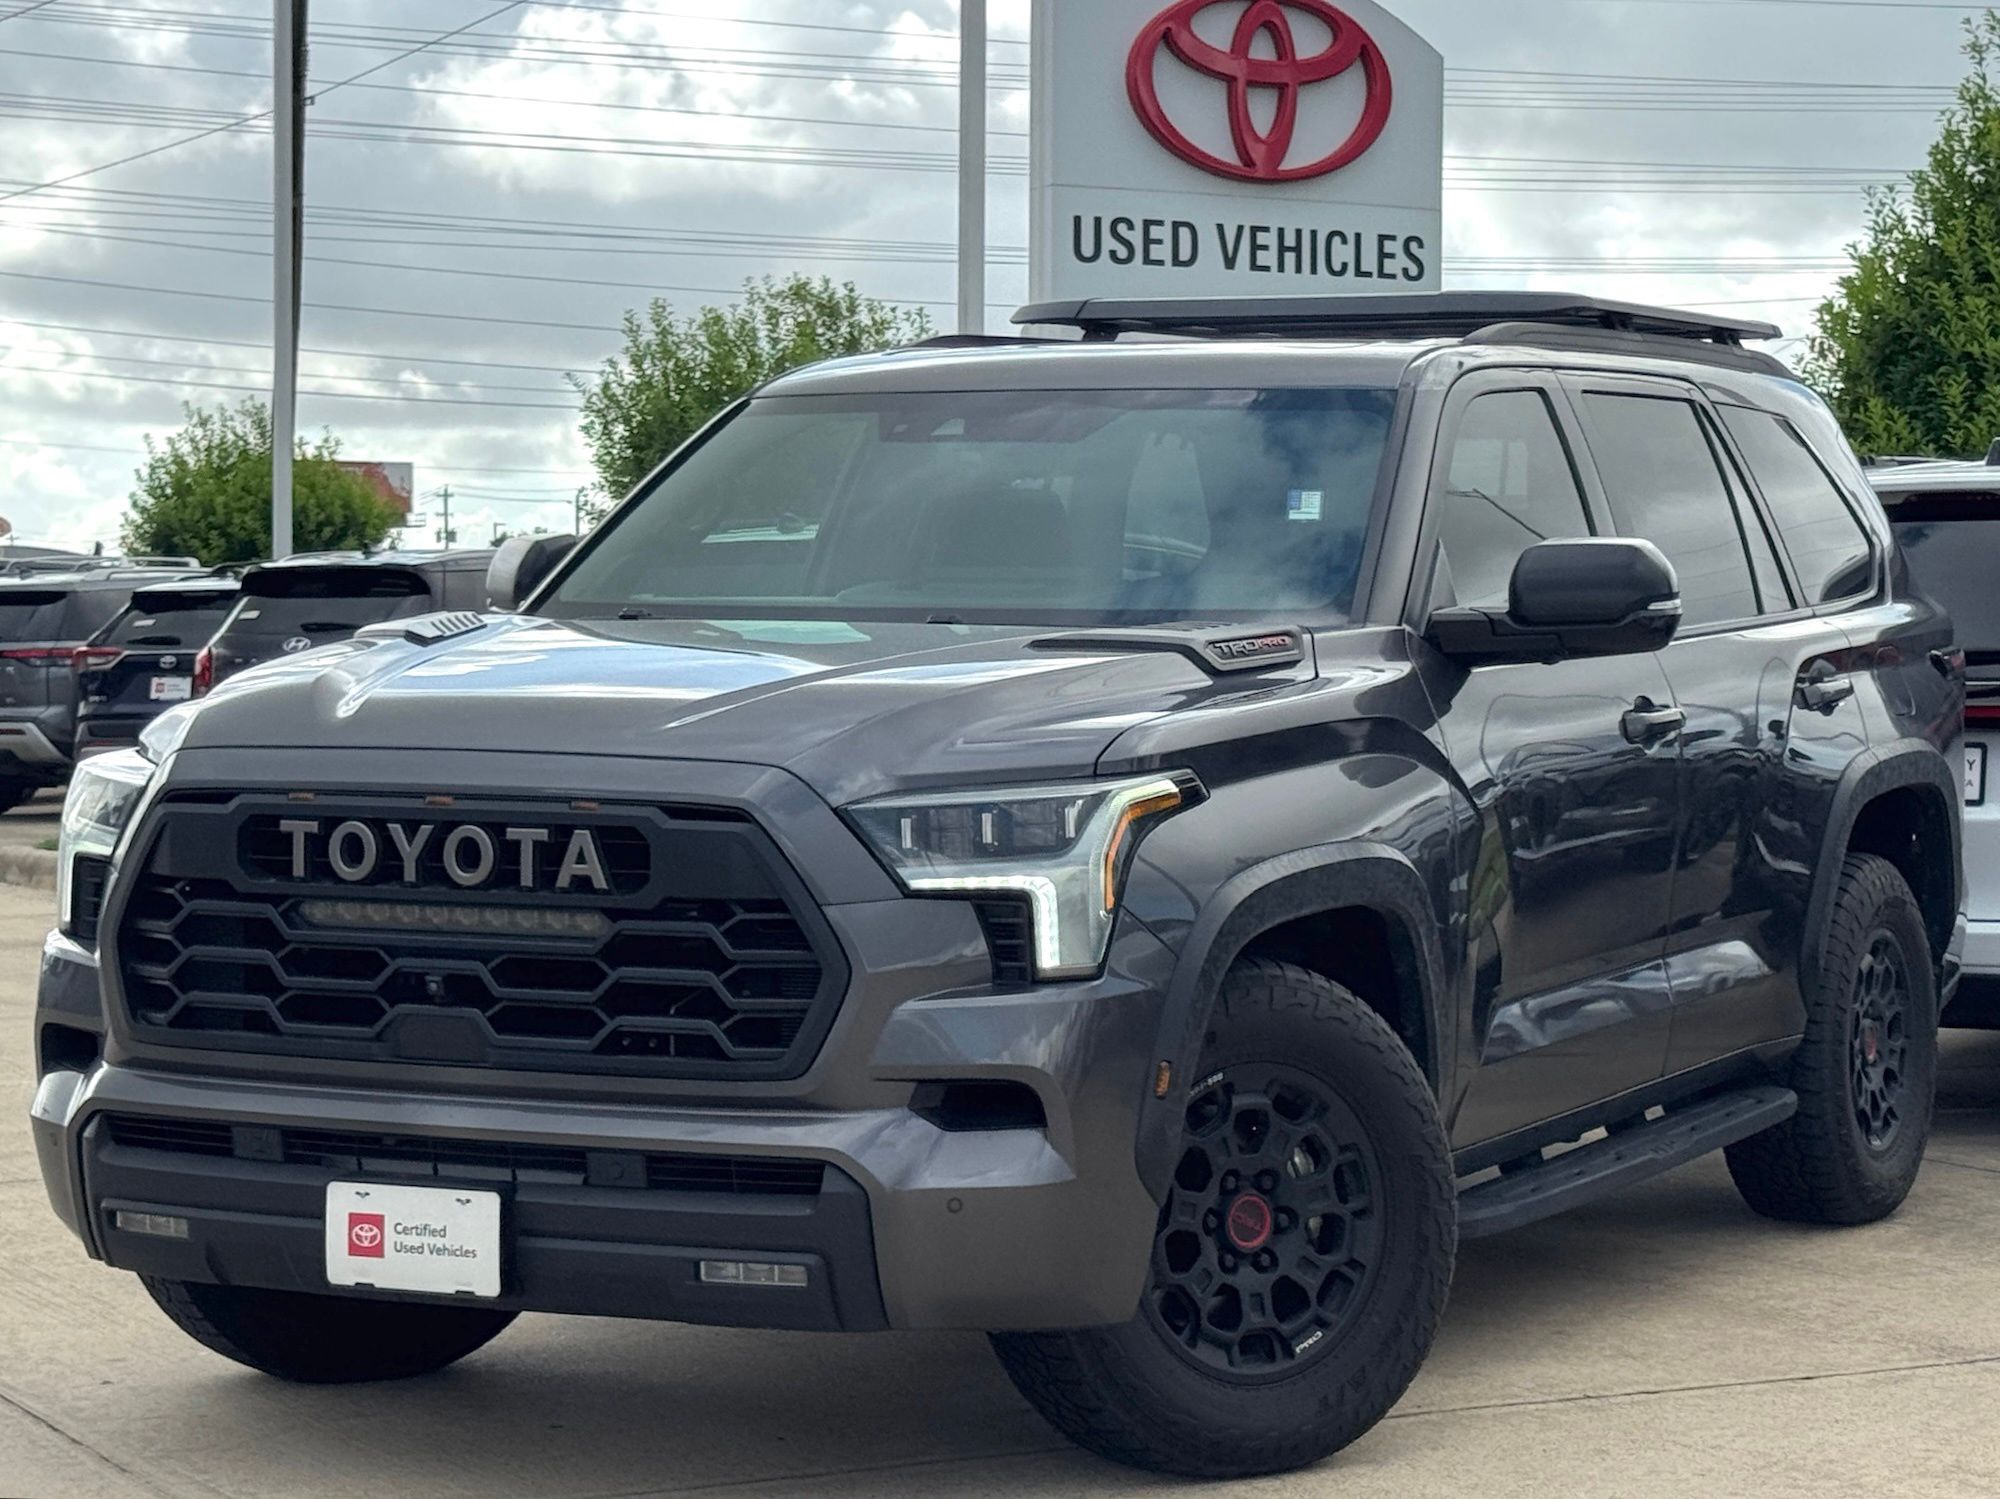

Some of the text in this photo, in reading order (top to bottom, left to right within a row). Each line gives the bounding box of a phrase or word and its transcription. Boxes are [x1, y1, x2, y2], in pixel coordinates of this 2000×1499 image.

[1072, 214, 1425, 282] USED VEHICLES
[1214, 639, 1258, 656] TRD
[279, 819, 609, 891] TOYOTA
[393, 1222, 447, 1239] Certified
[393, 1240, 478, 1260] Used Vehicles
